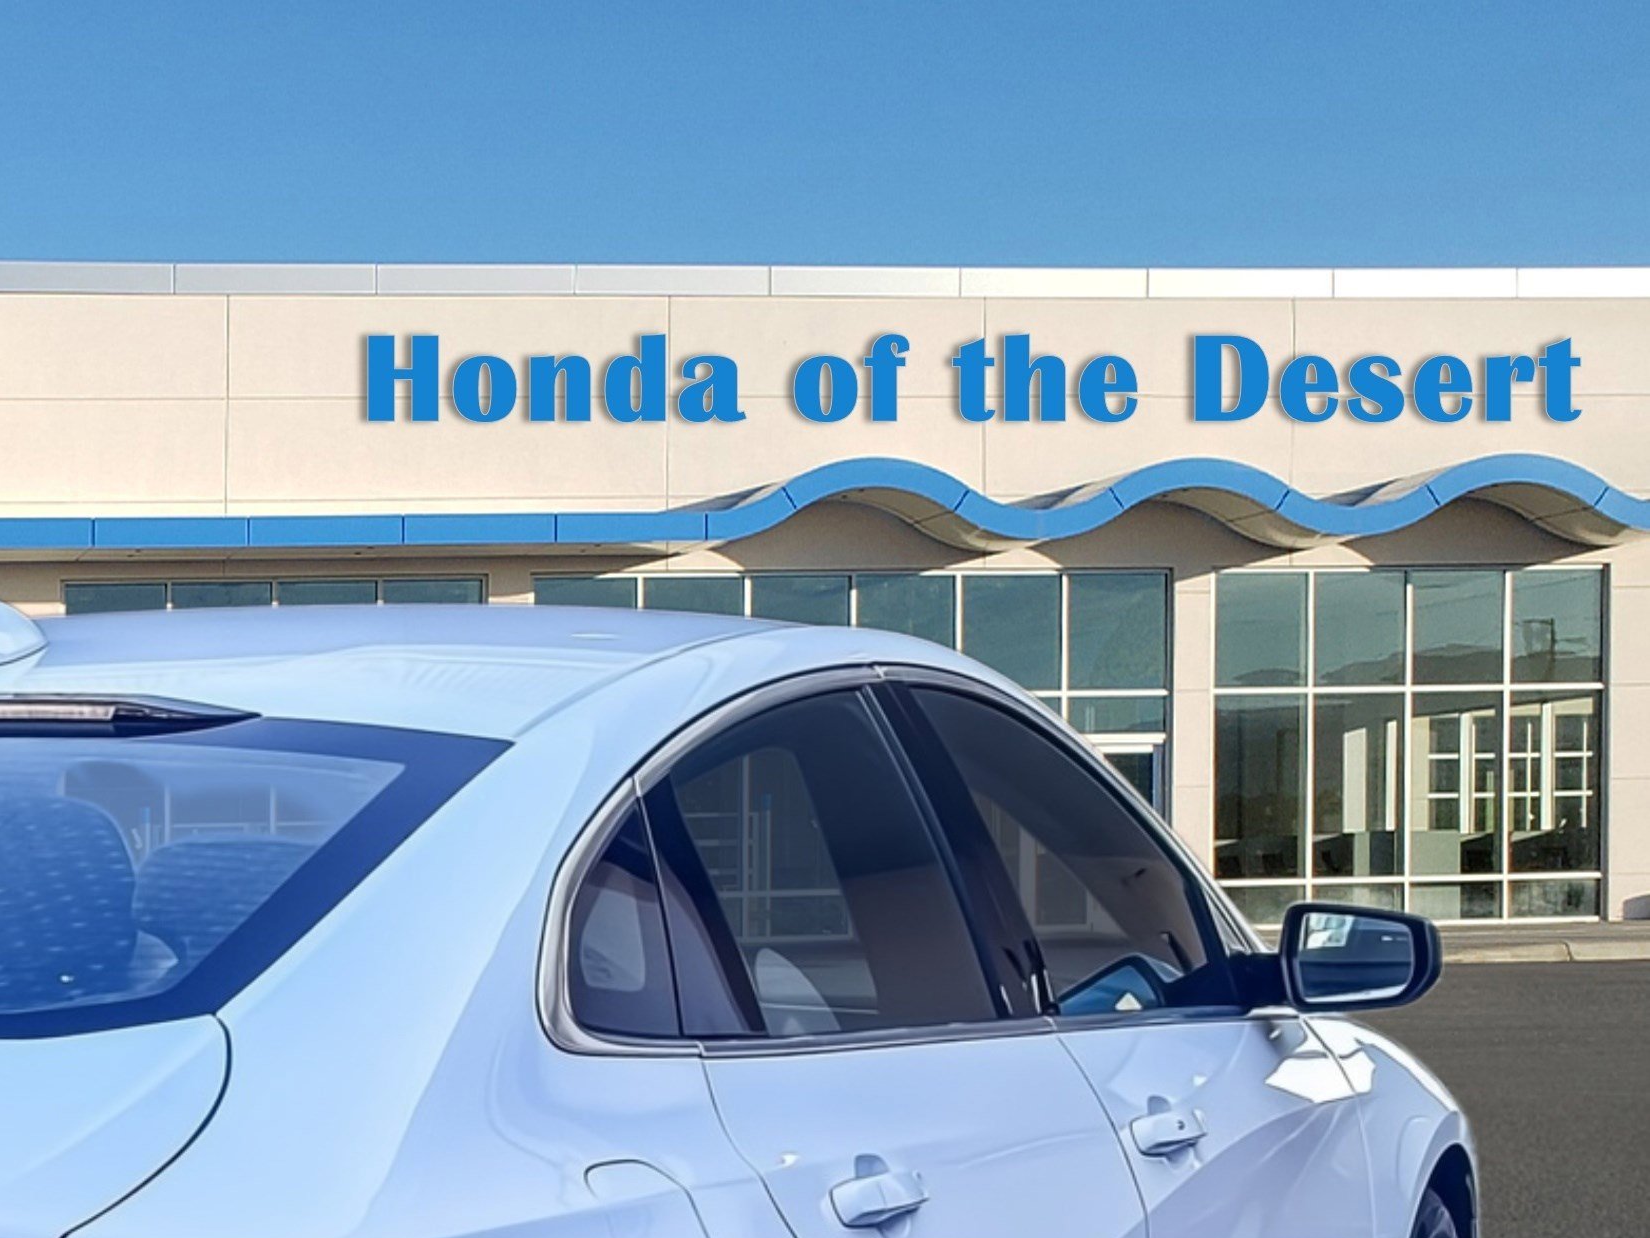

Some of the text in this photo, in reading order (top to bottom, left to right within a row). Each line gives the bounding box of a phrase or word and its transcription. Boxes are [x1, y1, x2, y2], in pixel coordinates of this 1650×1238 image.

[366, 333, 1582, 424] Honda of the Desert
